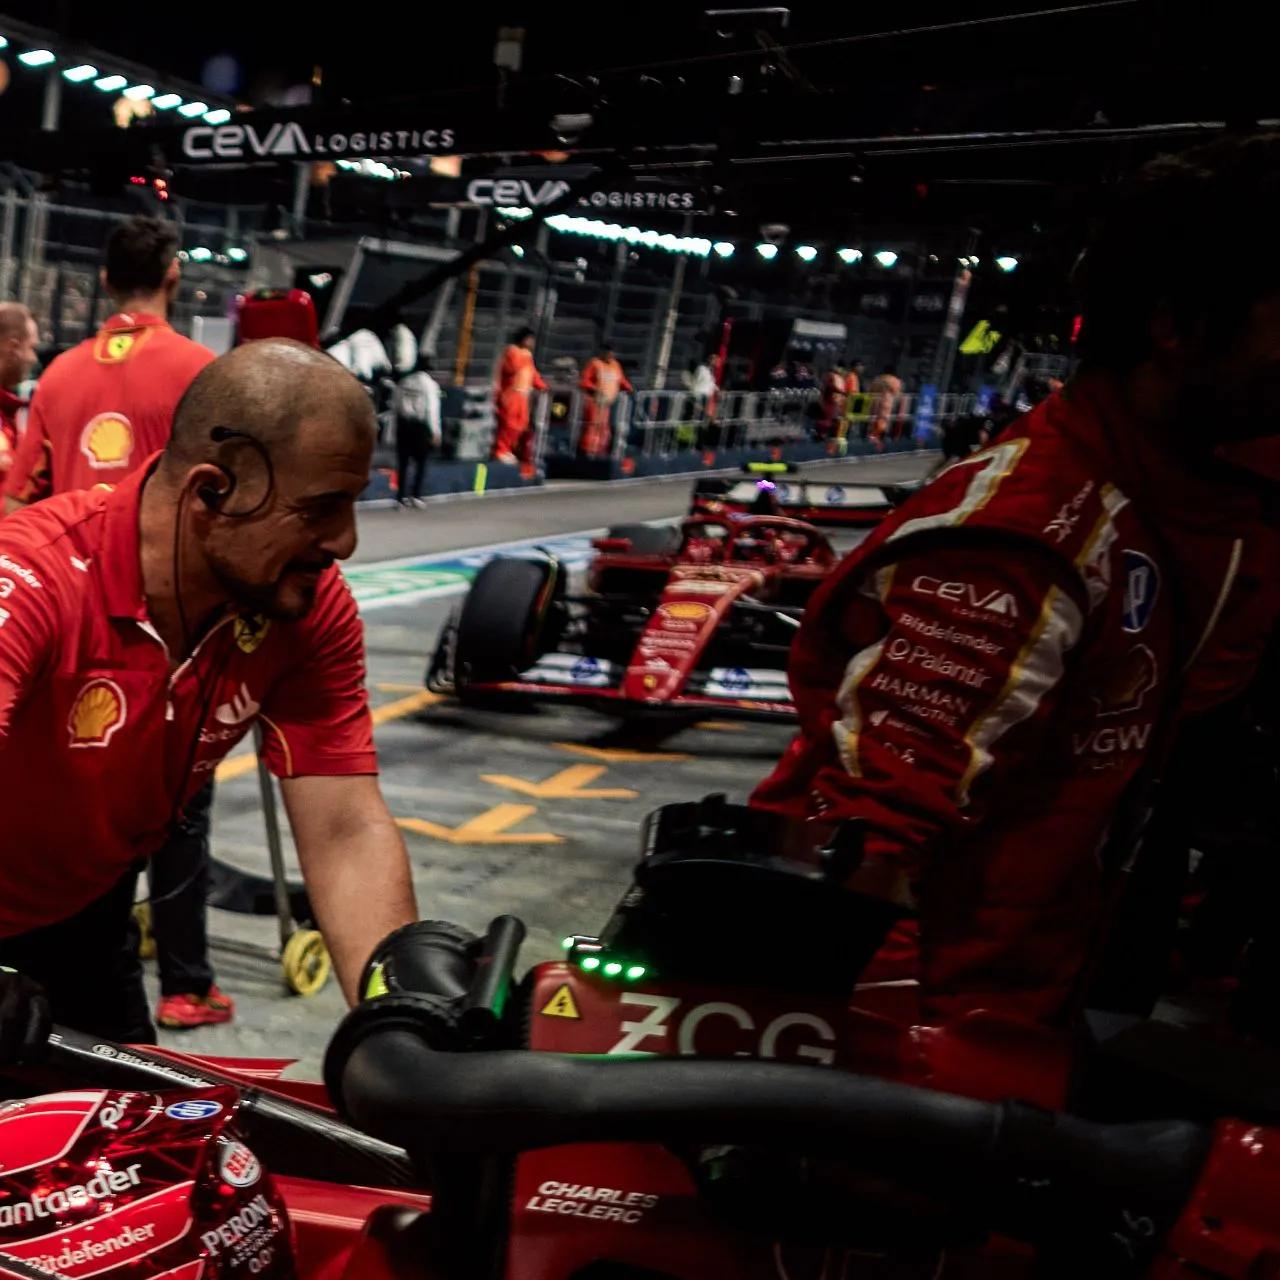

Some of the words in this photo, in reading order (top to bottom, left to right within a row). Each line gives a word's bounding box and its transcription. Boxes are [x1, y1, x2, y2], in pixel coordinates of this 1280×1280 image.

[182, 121, 312, 158] CEVA
[314, 128, 455, 152] LOGISTICS
[912, 576, 1019, 618] CEVA
[897, 611, 1006, 656] Bitdefender
[907, 644, 992, 689] Palantir
[871, 672, 970, 714] HARMAN
[1072, 723, 1152, 755] VGW
[608, 991, 838, 1065] ZCG
[525, 1196, 644, 1225] LECLERC
[537, 1180, 660, 1209] CHARLES
